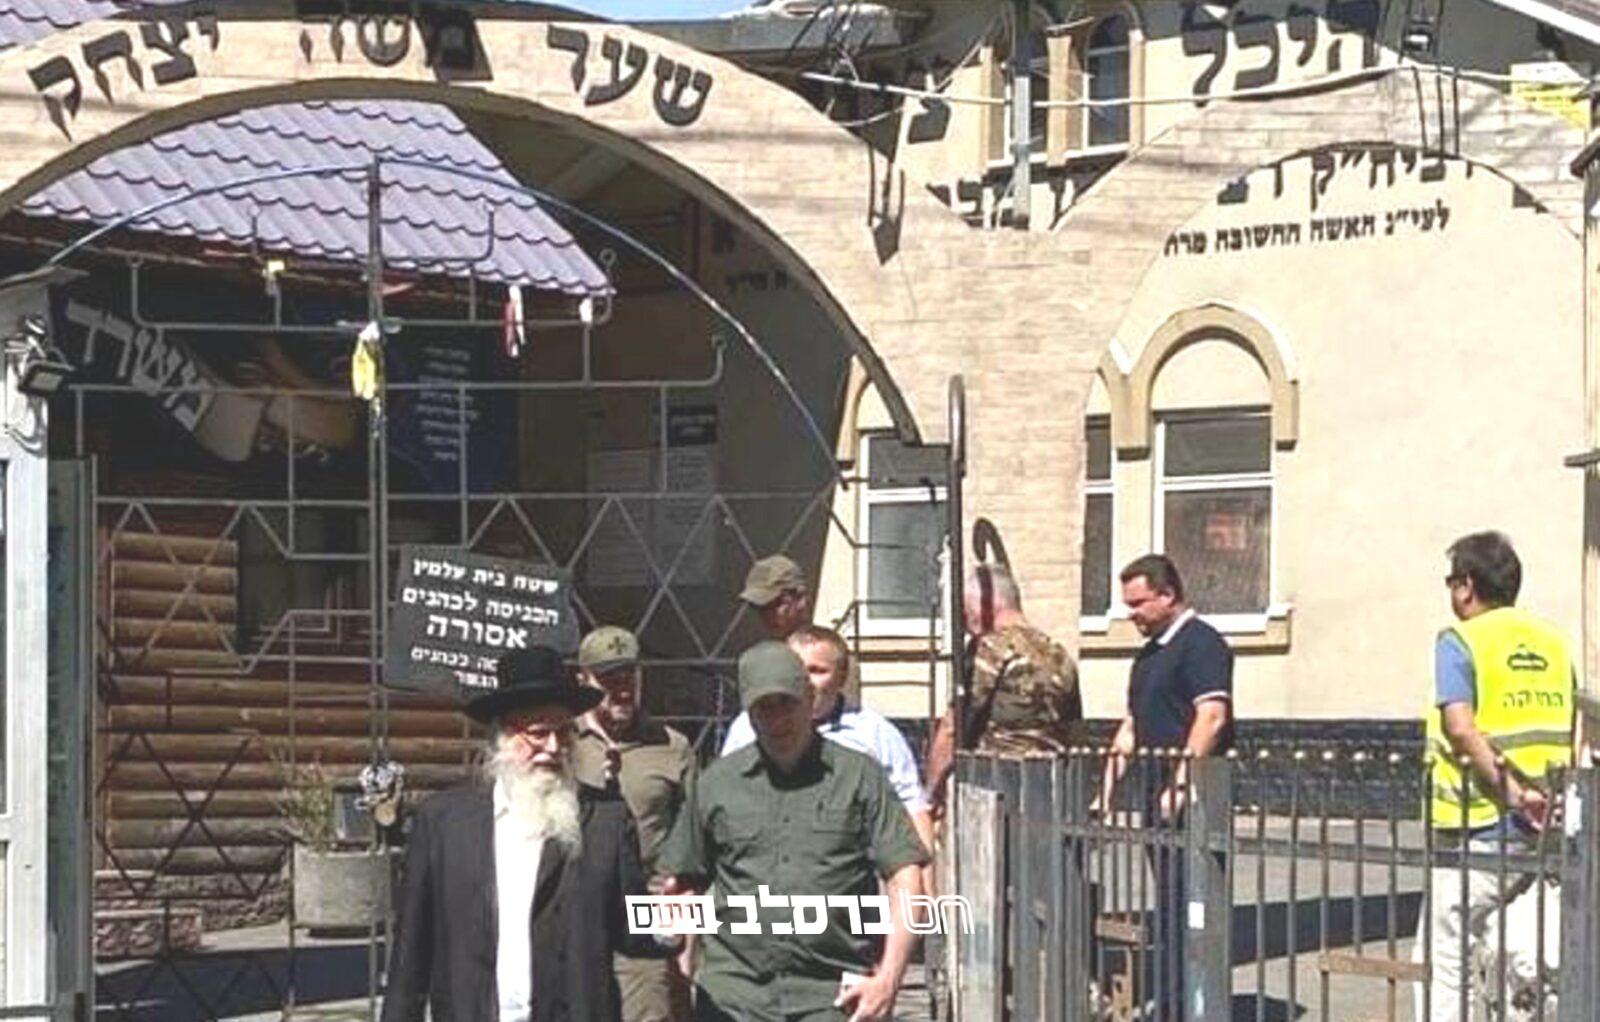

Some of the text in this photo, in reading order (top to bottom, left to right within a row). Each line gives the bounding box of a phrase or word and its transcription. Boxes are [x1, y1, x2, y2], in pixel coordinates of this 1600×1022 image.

[26, 14, 220, 143] יצחק
[546, 23, 714, 127] שער
[1181, 0, 1381, 108] היכל
[402, 586, 559, 626] הכניסה לכהנים
[413, 558, 559, 594] שטח בית עלמין
[426, 614, 528, 649] אסורה
